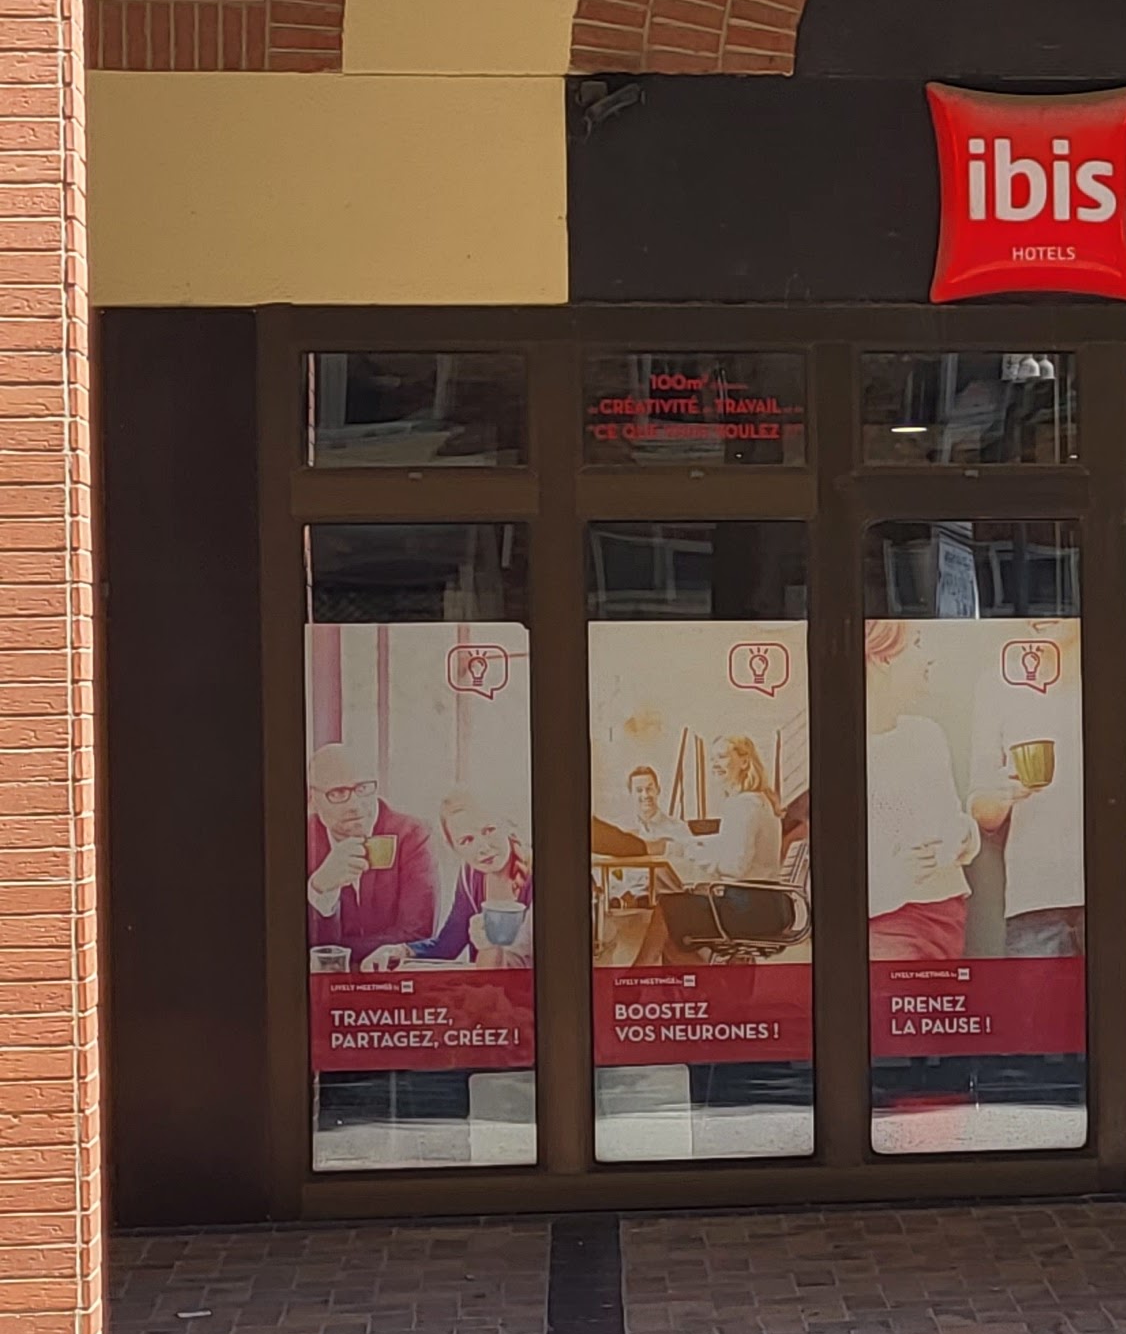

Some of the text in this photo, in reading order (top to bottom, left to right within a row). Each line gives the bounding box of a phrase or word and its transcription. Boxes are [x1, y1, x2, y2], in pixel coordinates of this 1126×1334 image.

[968, 137, 1117, 222] ibis
[1012, 246, 1076, 261] HOTELS
[714, 398, 781, 414] TRAVAIL
[615, 1002, 708, 1019] BOOSTEZ
[891, 996, 966, 1013] PRENEZ
[331, 1008, 453, 1026] TRAVAILLEZ,
[891, 1016, 992, 1035] LA PAUSE !
[331, 1024, 519, 1049] PARTAGEZ, CRÉEZ !
[615, 1022, 779, 1042] VOS NEURONES !
